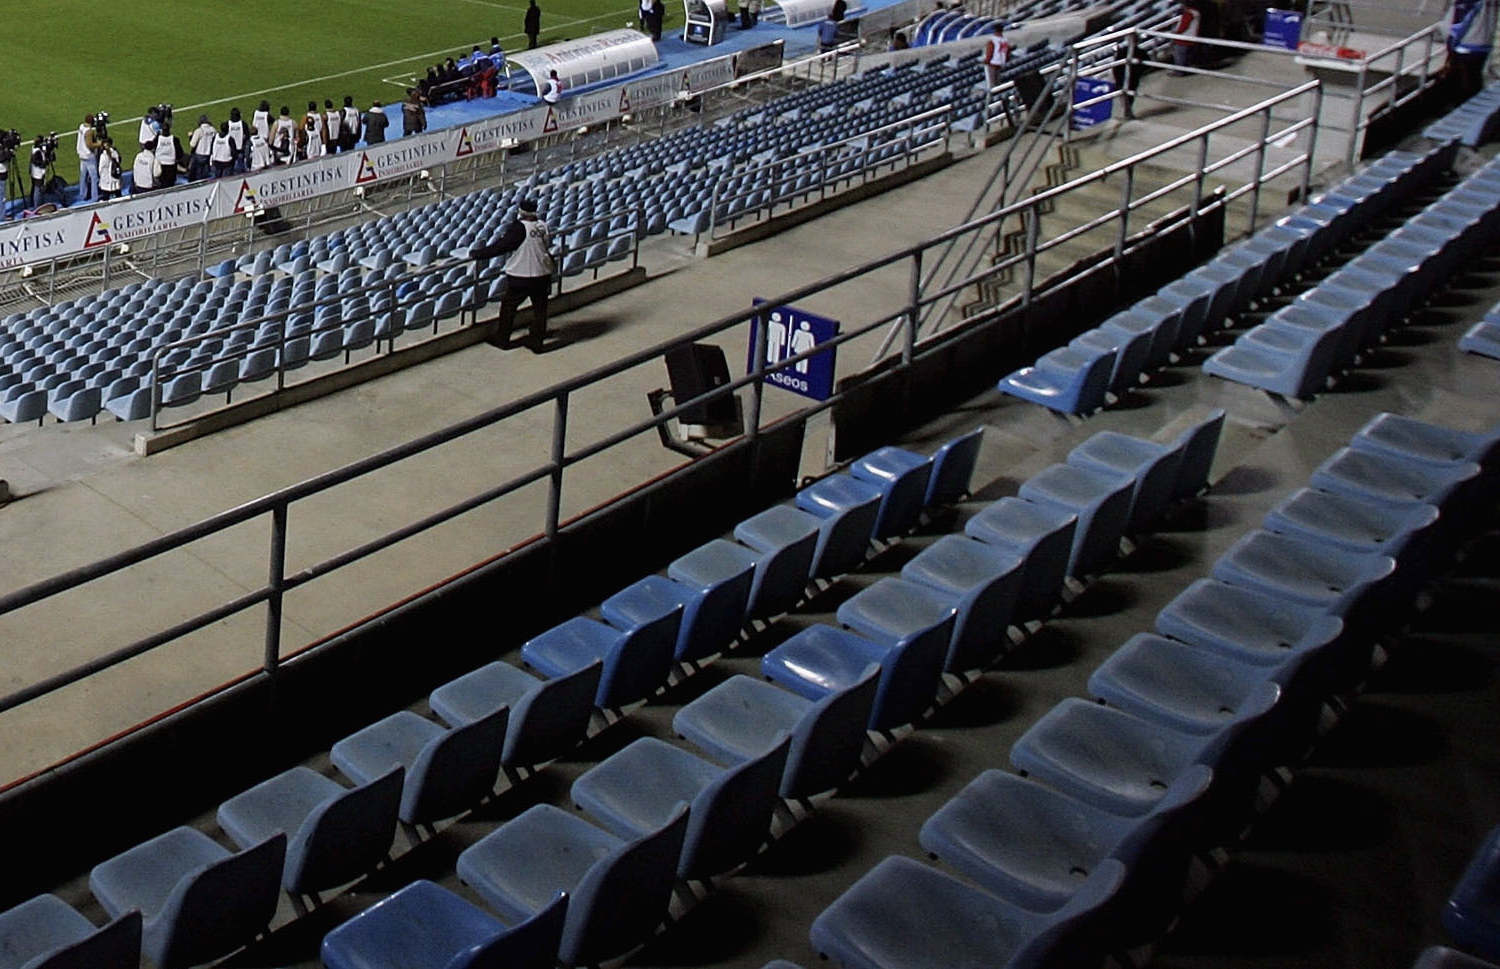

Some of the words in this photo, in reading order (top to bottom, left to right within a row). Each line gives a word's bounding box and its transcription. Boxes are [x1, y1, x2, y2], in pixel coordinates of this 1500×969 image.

[474, 120, 535, 143] GESTINFISA
[377, 141, 446, 167] GESTINFISA
[259, 166, 343, 197] GESTINFISA
[113, 196, 212, 231] GESTINFISA
[114, 221, 178, 240] INMOBILIARIA
